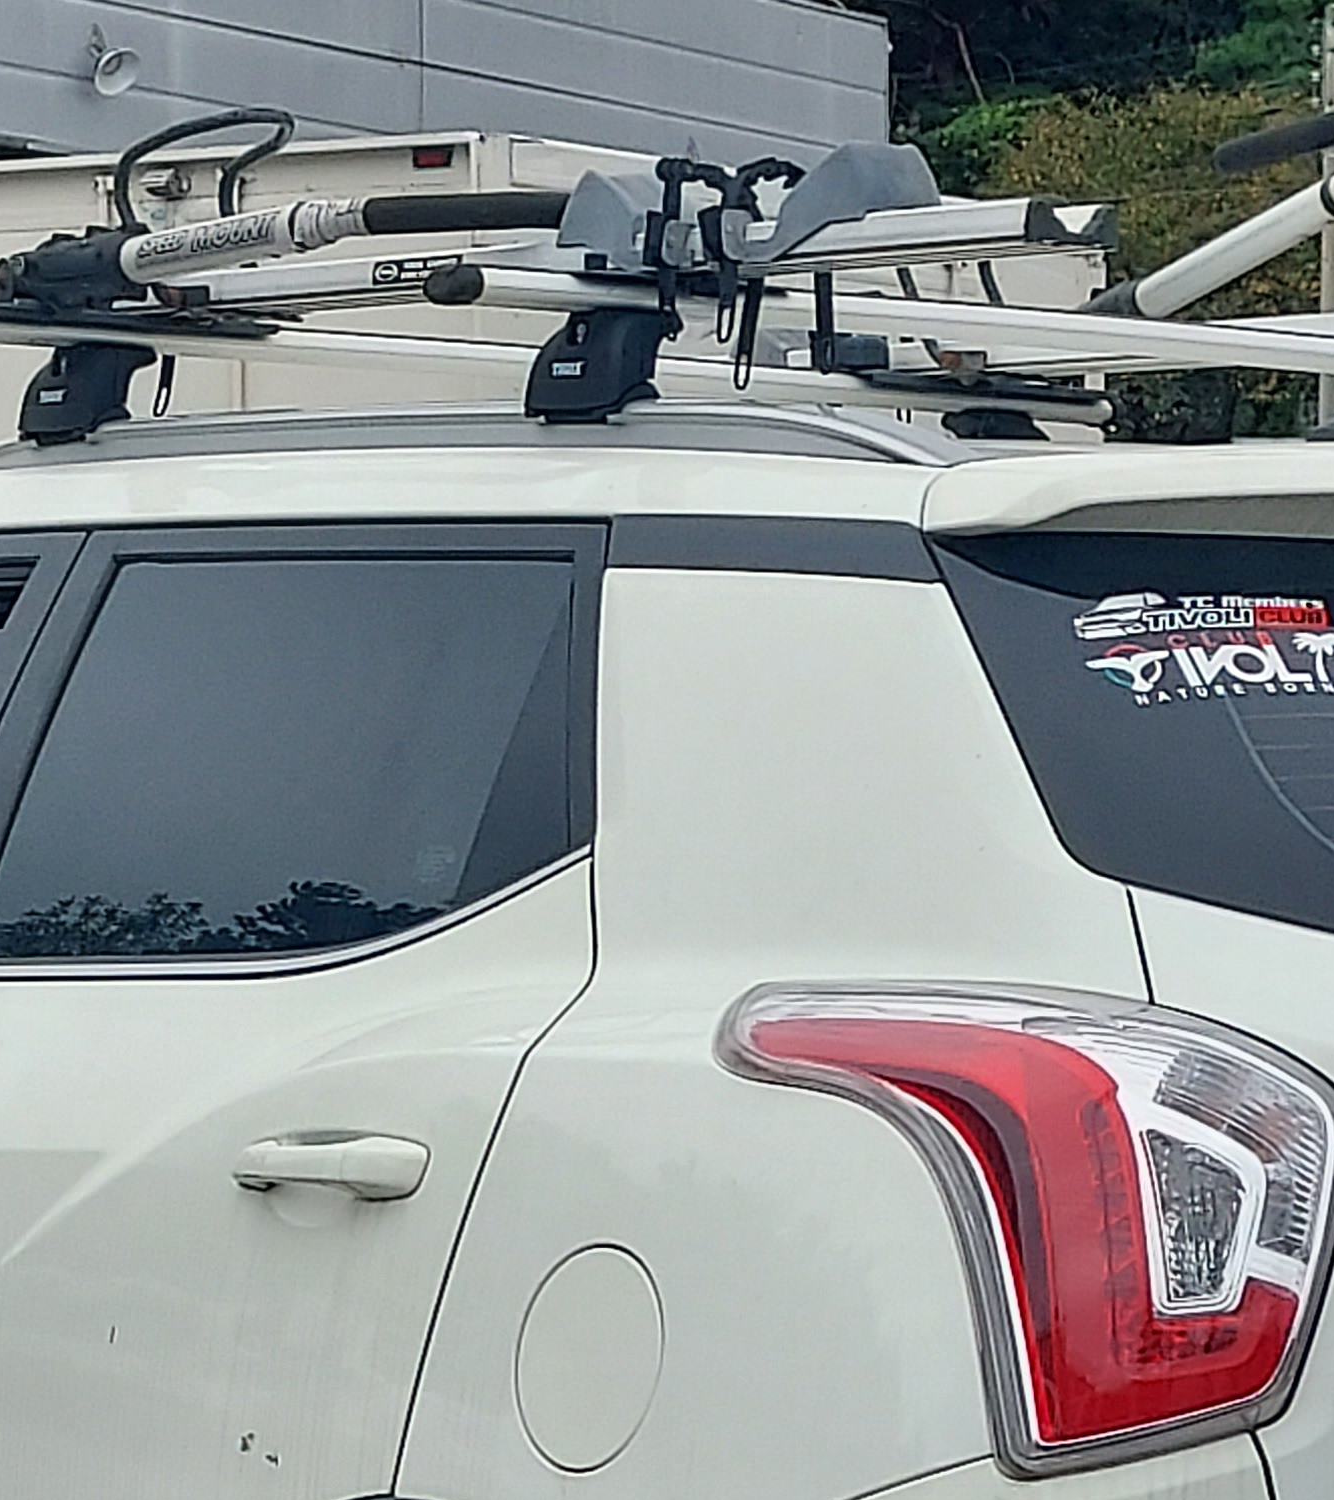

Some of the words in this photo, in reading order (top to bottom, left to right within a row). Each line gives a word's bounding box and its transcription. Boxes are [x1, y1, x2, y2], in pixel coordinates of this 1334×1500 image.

[1145, 608, 1253, 632] TIVOLI
[1167, 631, 1274, 648] CLUB
[1133, 682, 1247, 706] NATURE
